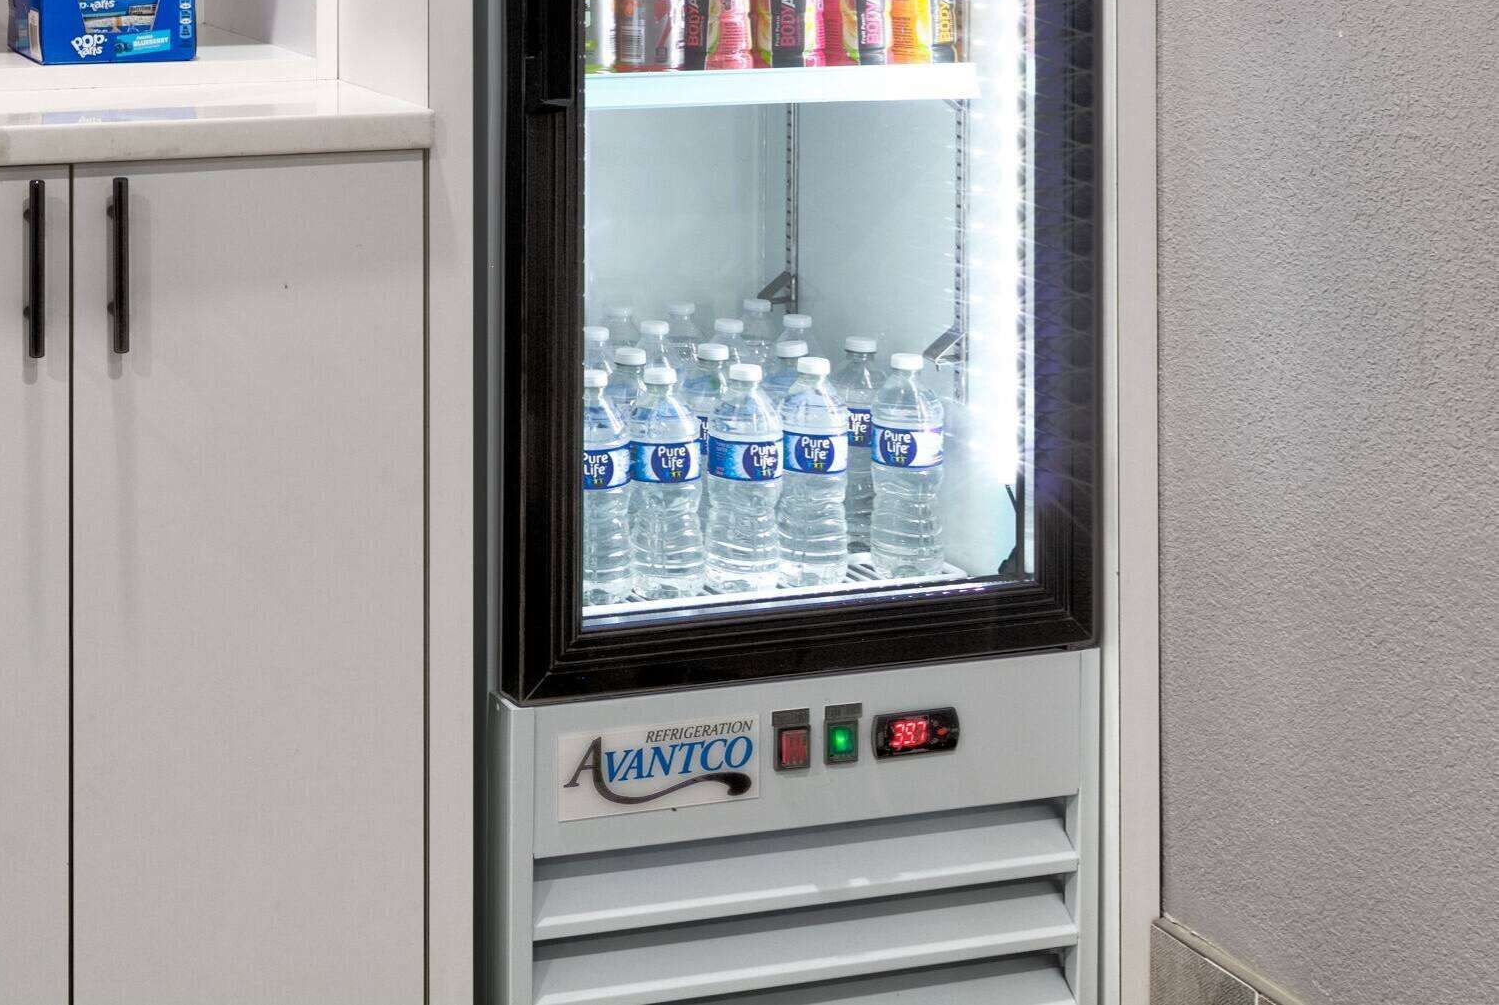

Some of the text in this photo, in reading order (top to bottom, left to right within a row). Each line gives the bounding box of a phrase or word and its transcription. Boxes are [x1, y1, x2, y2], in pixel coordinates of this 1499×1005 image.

[801, 436, 831, 449] Pure
[884, 430, 912, 444] Pure
[657, 446, 686, 460] Pure
[750, 443, 778, 456] Pure
[804, 448, 828, 463] Life
[886, 442, 910, 457] Life
[661, 456, 685, 471] Life
[753, 453, 777, 468] Life
[584, 463, 606, 477] Life
[645, 719, 754, 744] REFRIGERATION
[563, 735, 753, 788] AVANTCO
